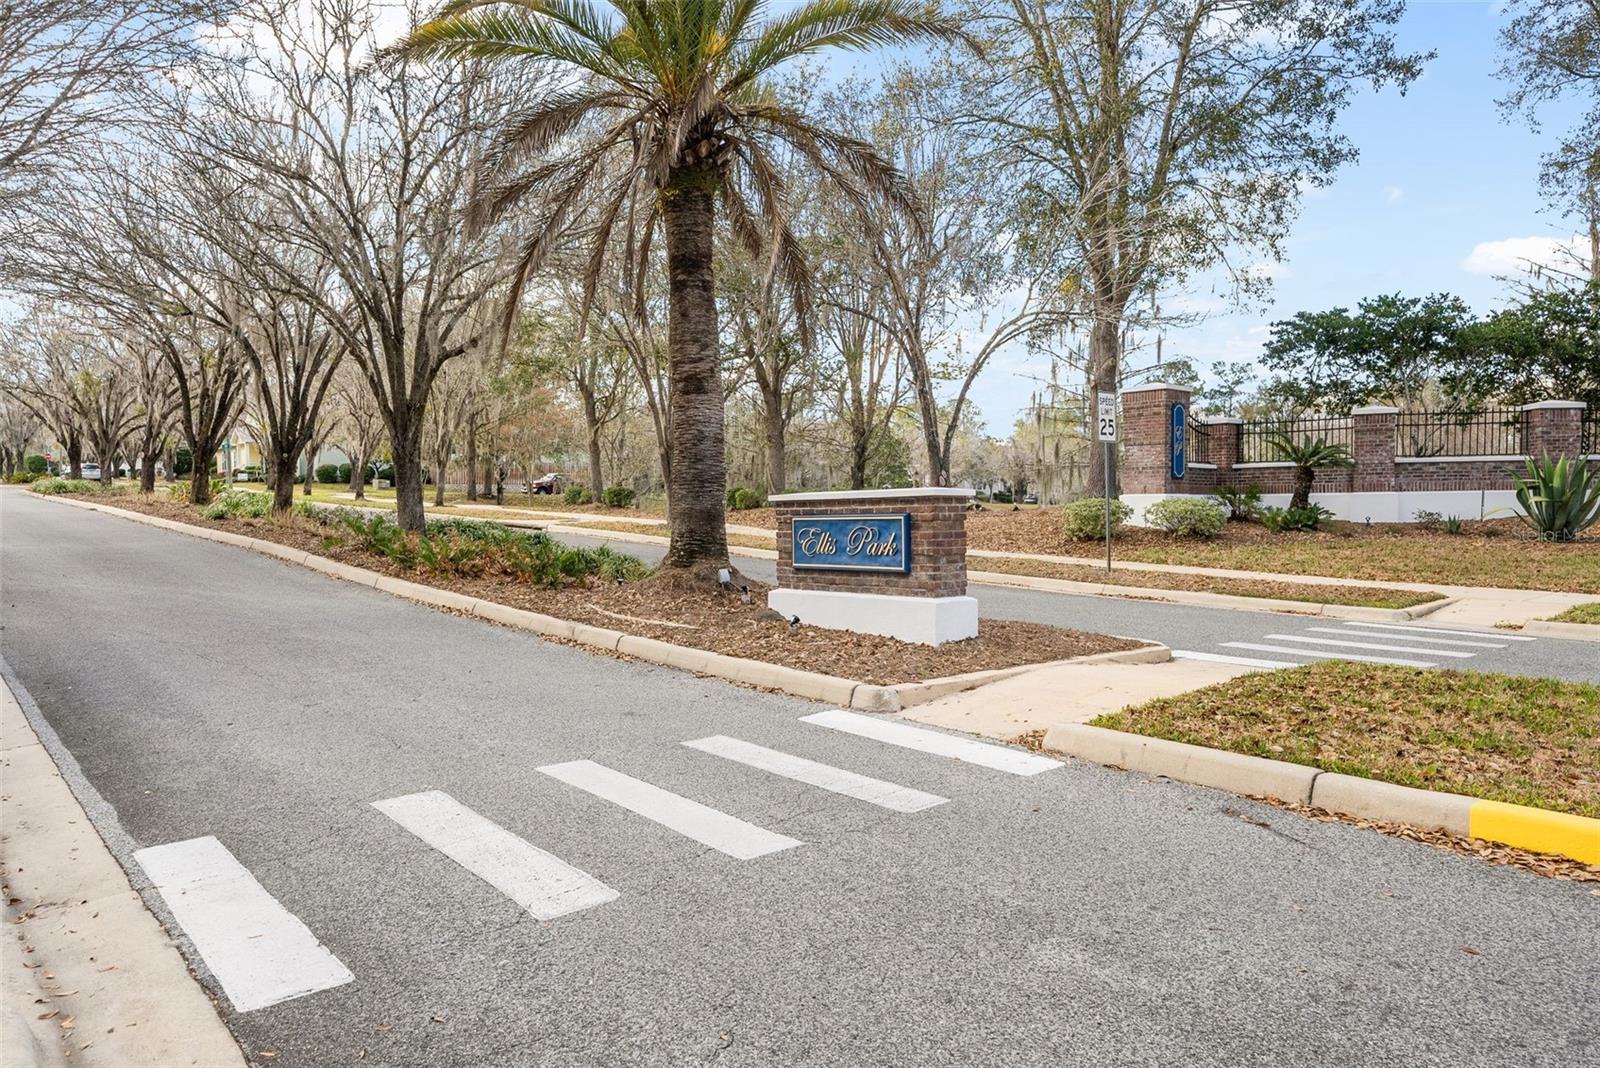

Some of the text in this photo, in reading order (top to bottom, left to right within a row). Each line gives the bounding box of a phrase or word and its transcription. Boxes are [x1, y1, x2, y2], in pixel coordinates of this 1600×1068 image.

[1099, 396, 1114, 406] SPEED
[1100, 418, 1115, 436] 25
[798, 525, 898, 558] Ellis Park
